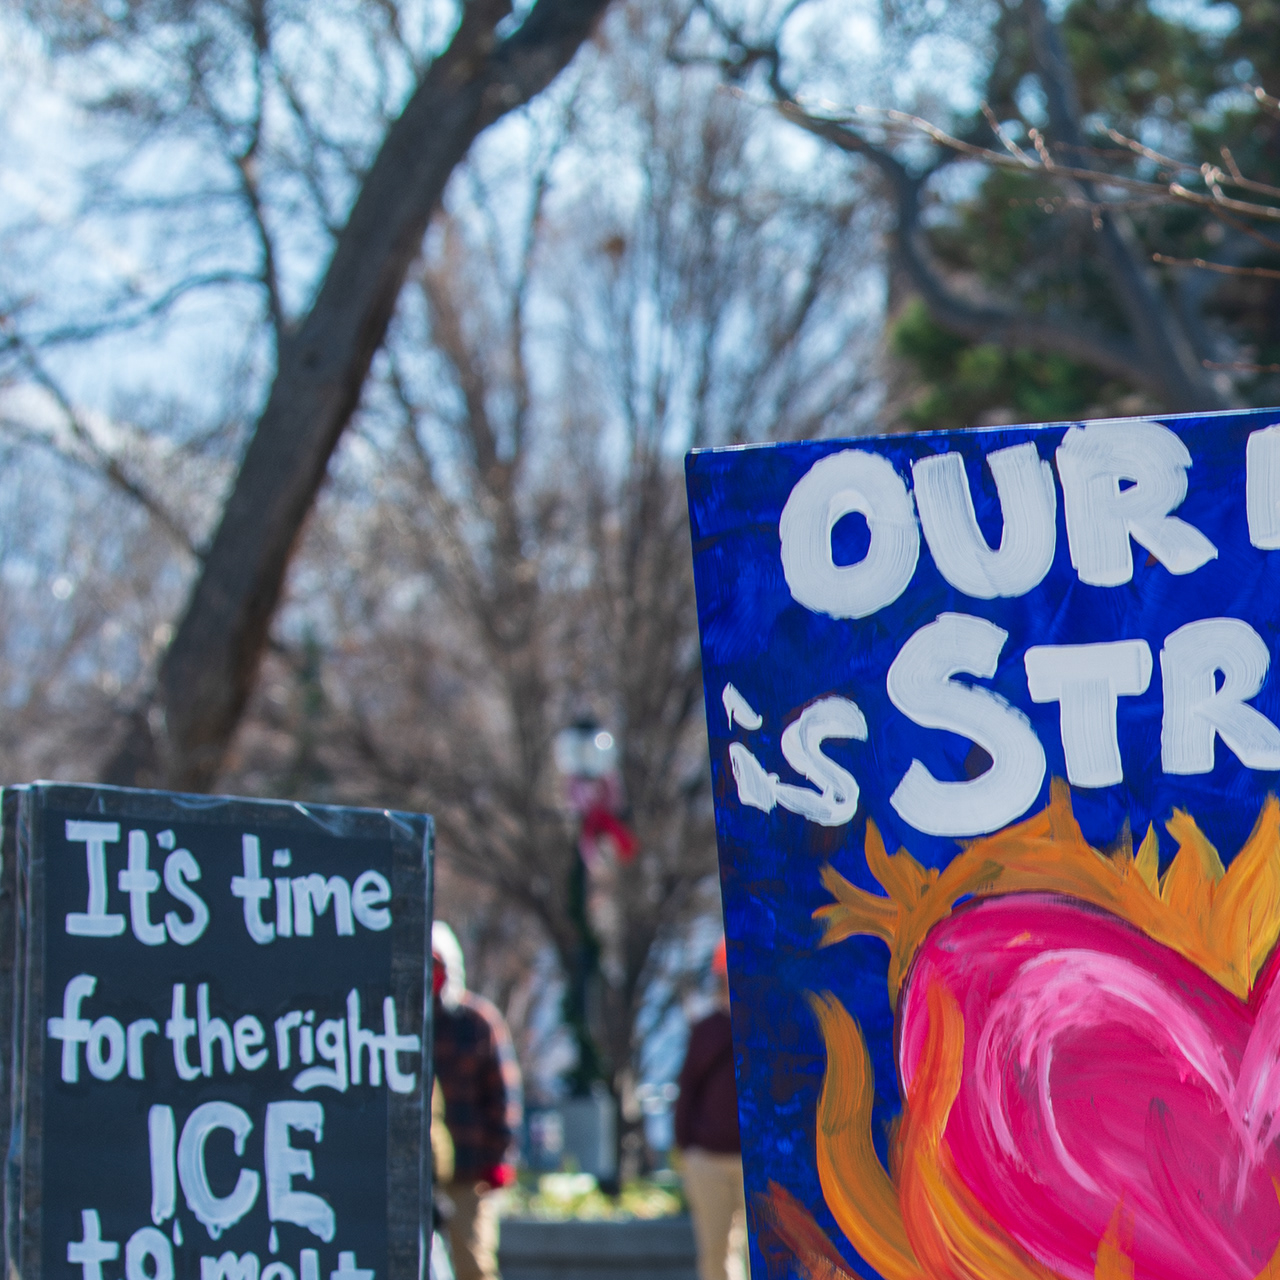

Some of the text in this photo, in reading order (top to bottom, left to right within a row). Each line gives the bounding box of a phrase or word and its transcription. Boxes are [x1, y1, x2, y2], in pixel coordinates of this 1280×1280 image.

[778, 418, 1219, 620] OUR
[65, 820, 393, 946] It's time
[48, 974, 421, 1094] for the right
[147, 1100, 335, 1243] ICE
